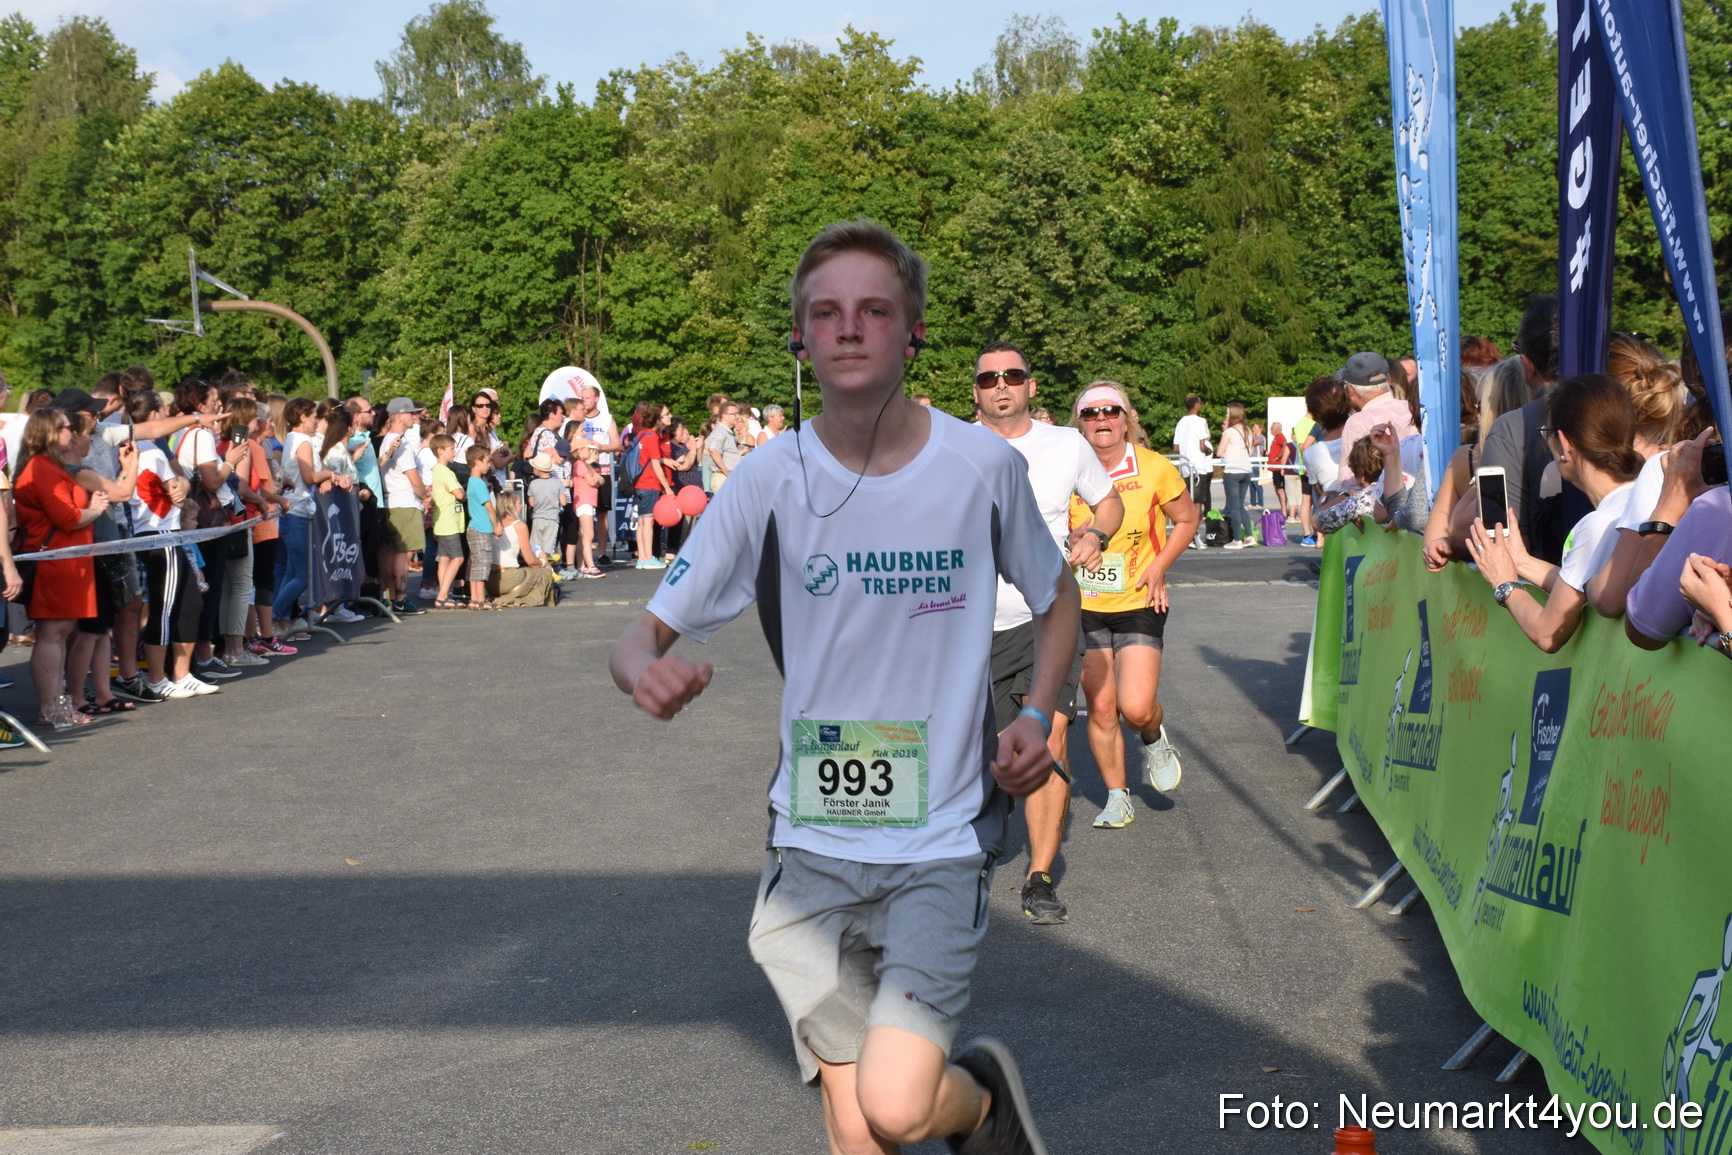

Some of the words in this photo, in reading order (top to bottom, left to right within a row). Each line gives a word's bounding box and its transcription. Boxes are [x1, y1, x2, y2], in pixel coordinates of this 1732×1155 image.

[846, 549, 965, 573] HAUBNER
[861, 576, 952, 595] TREPPEN
[1537, 718, 1562, 746] Fischer
[810, 740, 861, 752] firmenlauf
[892, 749, 918, 758] 2019
[818, 758, 894, 797] 993
[823, 797, 860, 808] Förster
[861, 797, 891, 808] Janik
[864, 808, 886, 816] GmbH
